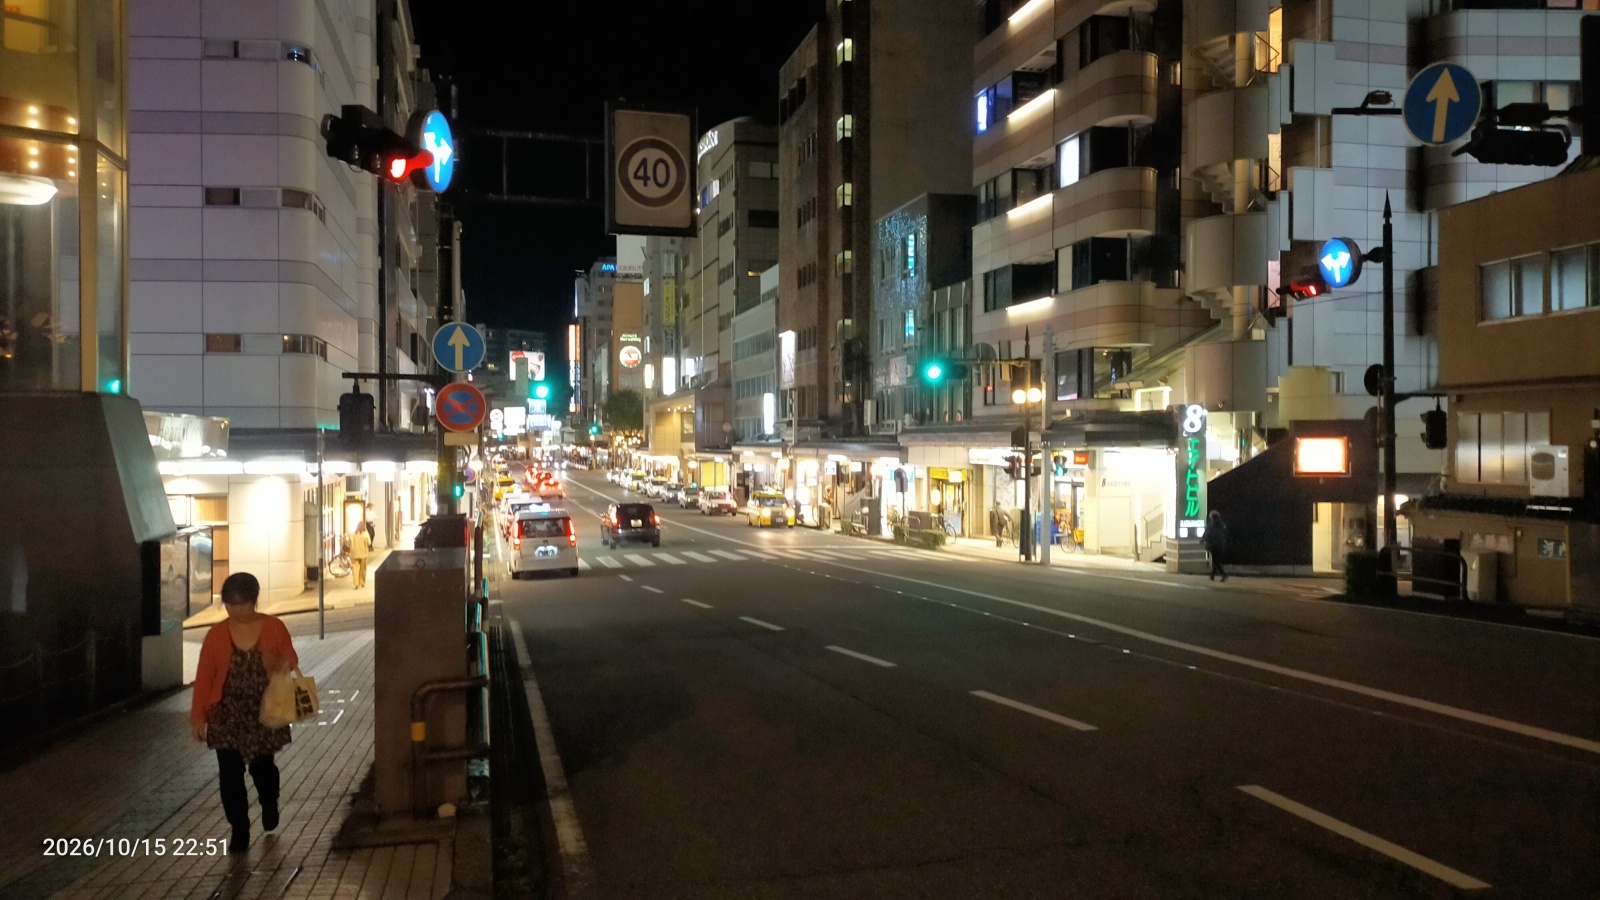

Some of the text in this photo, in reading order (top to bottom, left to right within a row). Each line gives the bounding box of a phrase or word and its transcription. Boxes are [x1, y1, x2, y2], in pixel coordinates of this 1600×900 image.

[633, 157, 671, 189] 40
[1183, 404, 1203, 433] 8
[1185, 437, 1200, 517] エイトビル
